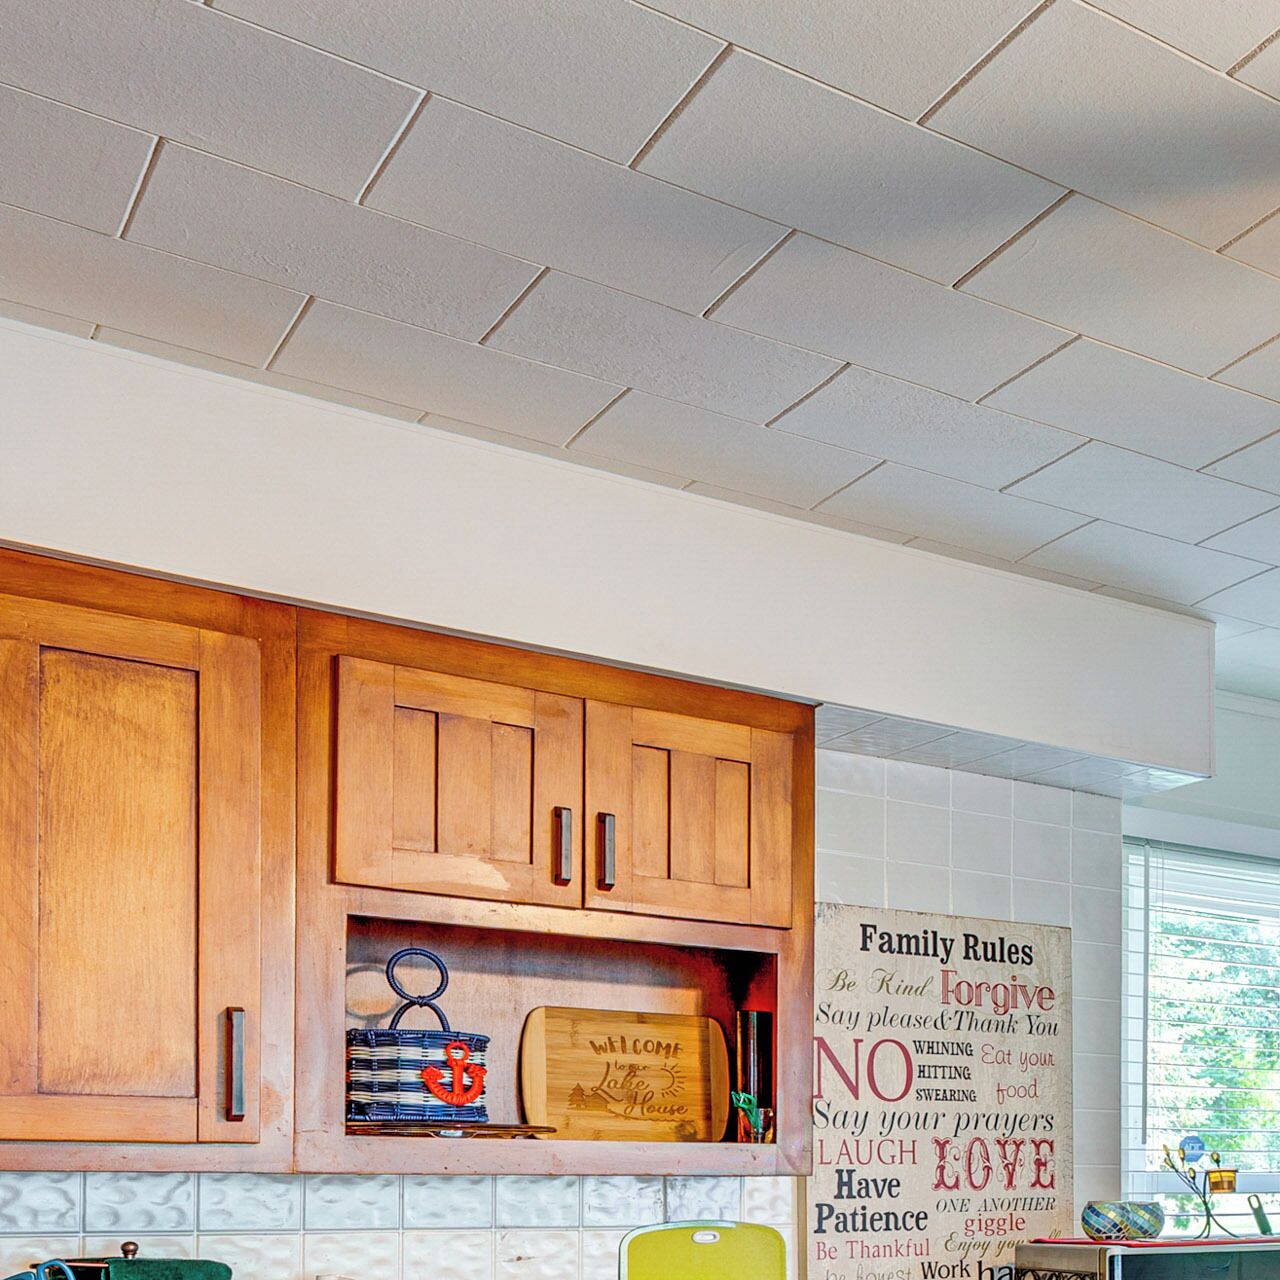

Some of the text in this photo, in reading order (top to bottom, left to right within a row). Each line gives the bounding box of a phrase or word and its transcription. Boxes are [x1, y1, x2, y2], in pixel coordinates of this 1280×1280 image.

[859, 923, 1033, 966] Family Rules
[822, 968, 934, 997] Be Kind
[940, 969, 1055, 1016] Forgive
[816, 1001, 860, 1031] Say
[1027, 1014, 1059, 1036] You
[589, 1035, 684, 1059] WELCOME
[913, 1040, 974, 1056] WHINING
[981, 1044, 1055, 1072] Eat your
[615, 1060, 626, 1070] to
[813, 1037, 913, 1102] NO
[917, 1065, 972, 1080] HITTING
[591, 1061, 650, 1102] Lake
[916, 1088, 977, 1102] SWEARING
[996, 1078, 1039, 1105] food
[623, 1090, 689, 1116] House
[813, 1099, 1054, 1138] Say your prayers
[818, 1139, 917, 1165] LAUGH
[931, 1136, 1056, 1192] LOVE
[834, 1169, 901, 1199] Have
[814, 1203, 928, 1234] Patience
[936, 1197, 1056, 1213] ONE ANOTHER
[964, 1213, 1026, 1237] giggle
[816, 1238, 930, 1260] Be Thankful
[944, 1231, 990, 1260] Enjoy
[920, 1260, 971, 1280] Work
